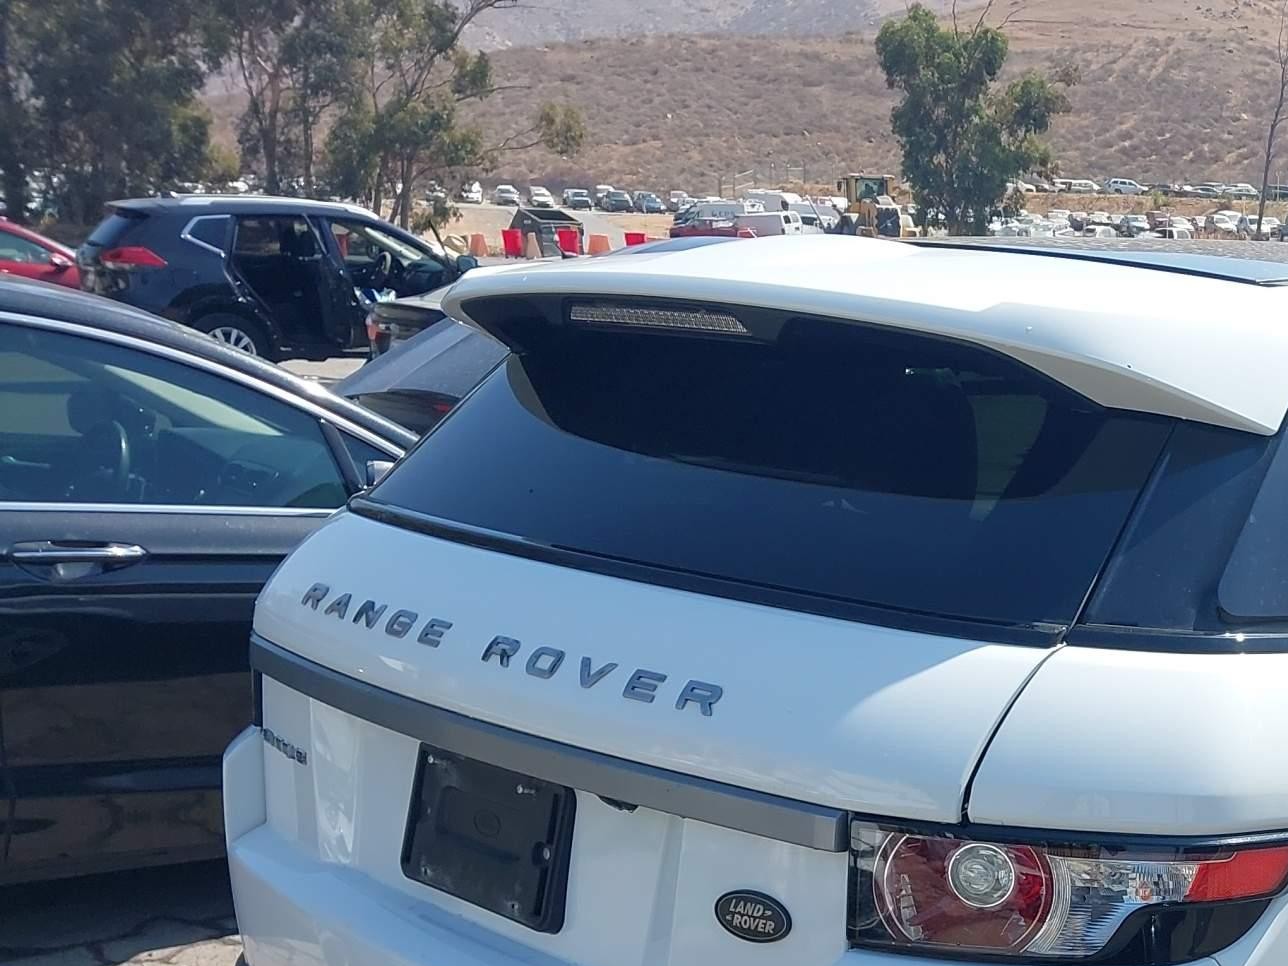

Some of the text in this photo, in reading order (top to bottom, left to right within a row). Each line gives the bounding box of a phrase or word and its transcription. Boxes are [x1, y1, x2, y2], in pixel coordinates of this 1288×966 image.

[300, 582, 723, 717] RANGE ROVER
[729, 899, 764, 917] LAND
[733, 914, 775, 934] ROVER
